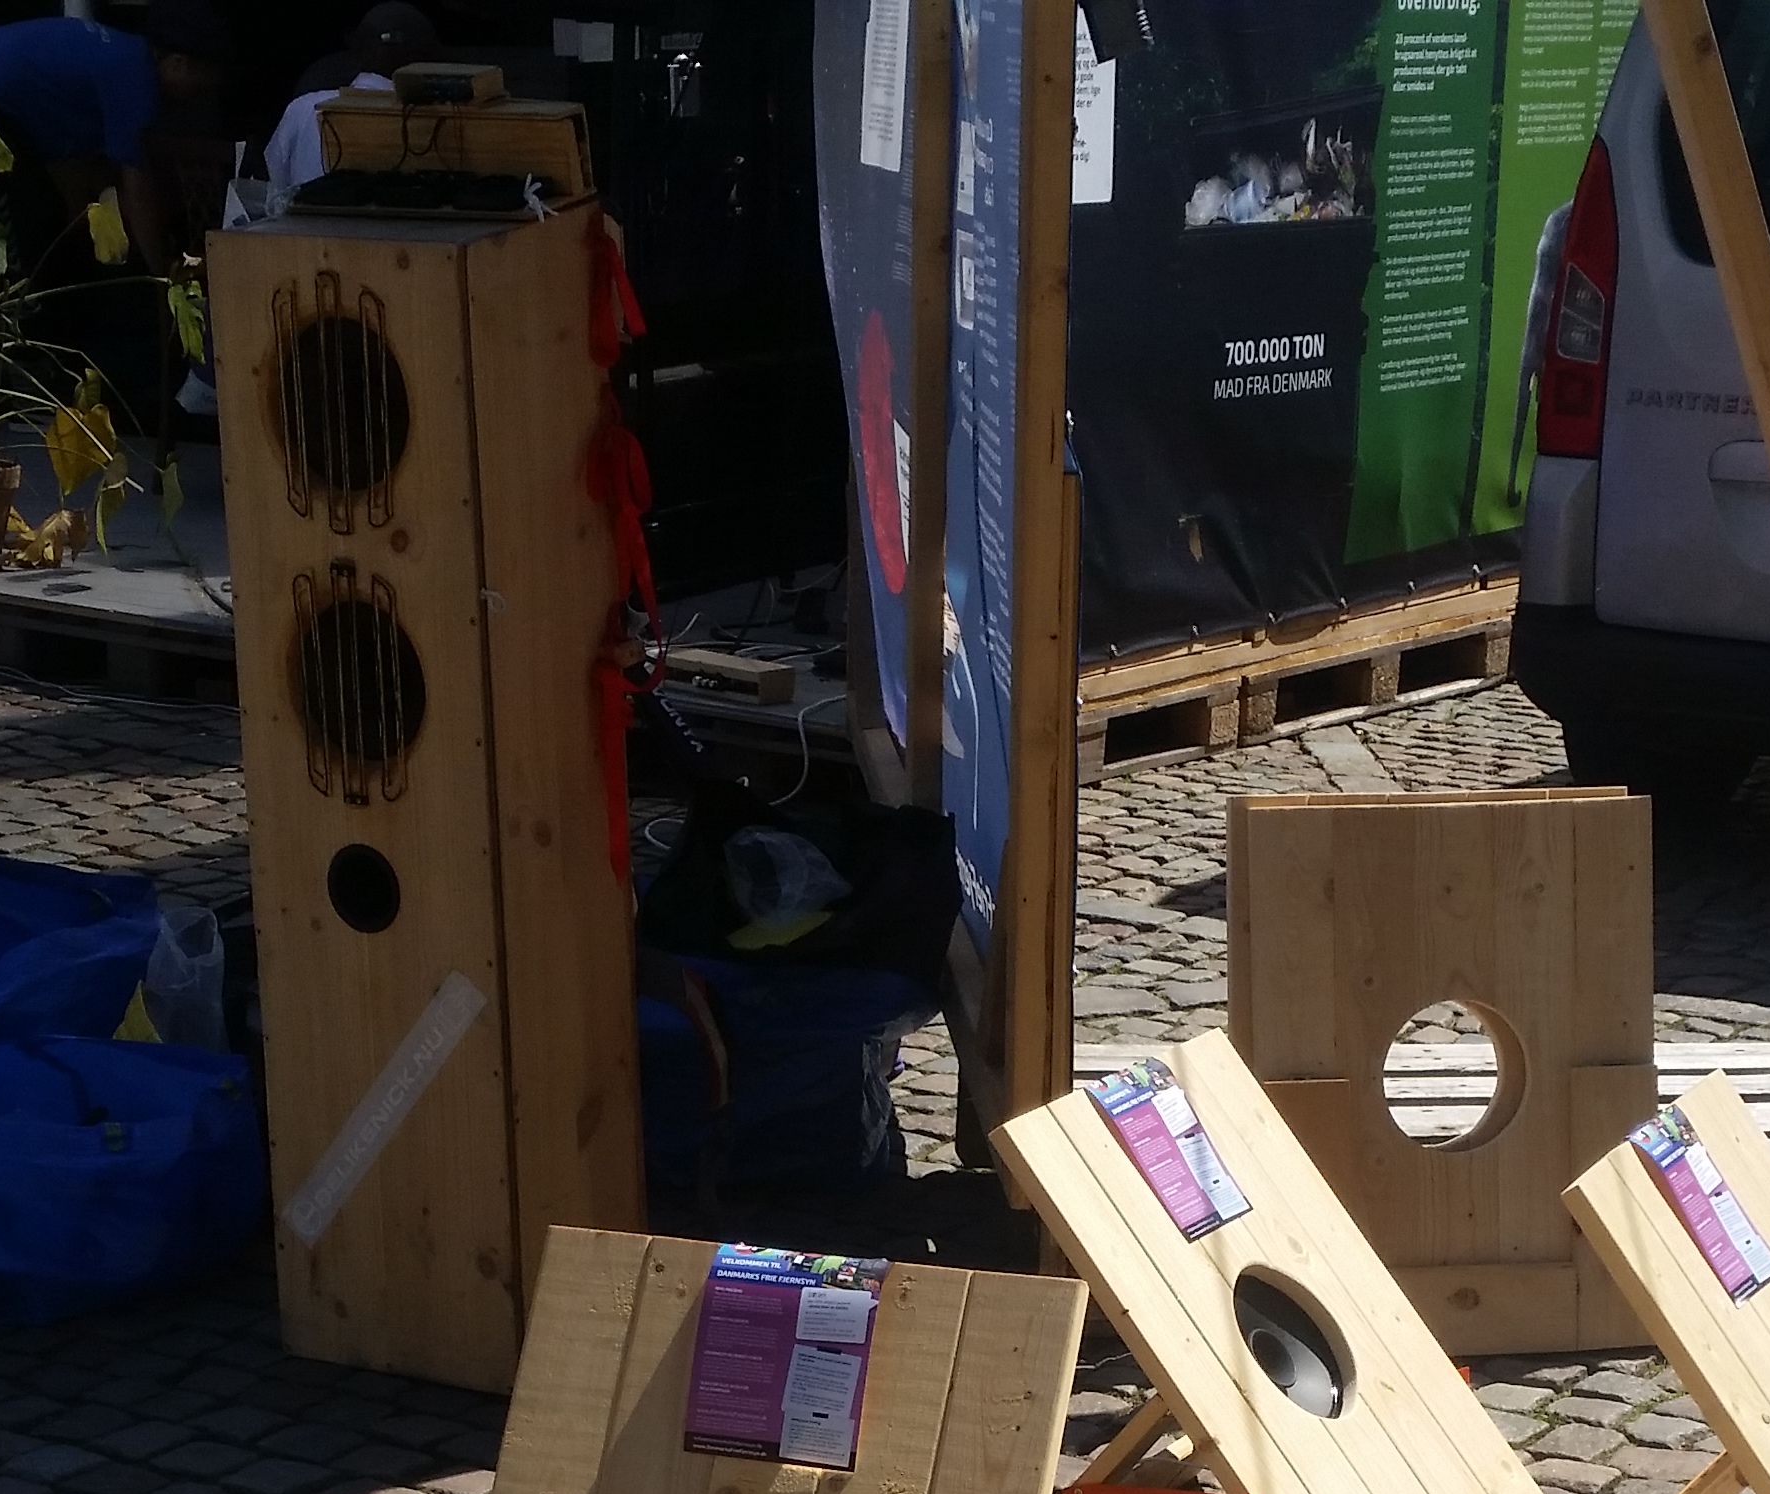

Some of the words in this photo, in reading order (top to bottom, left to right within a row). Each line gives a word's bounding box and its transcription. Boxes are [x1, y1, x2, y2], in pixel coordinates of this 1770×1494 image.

[1225, 337, 1290, 367] 700.000
[1292, 333, 1325, 360] TON
[1213, 377, 1244, 400] MAD
[1246, 374, 1270, 396] FRA
[1272, 367, 1333, 395] DENMARK
[721, 1257, 770, 1268] VELKOMMEN
[716, 1269, 760, 1281] DANMARKS
[760, 1273, 777, 1282] FRIE
[778, 1275, 817, 1287] FJERNSYN
